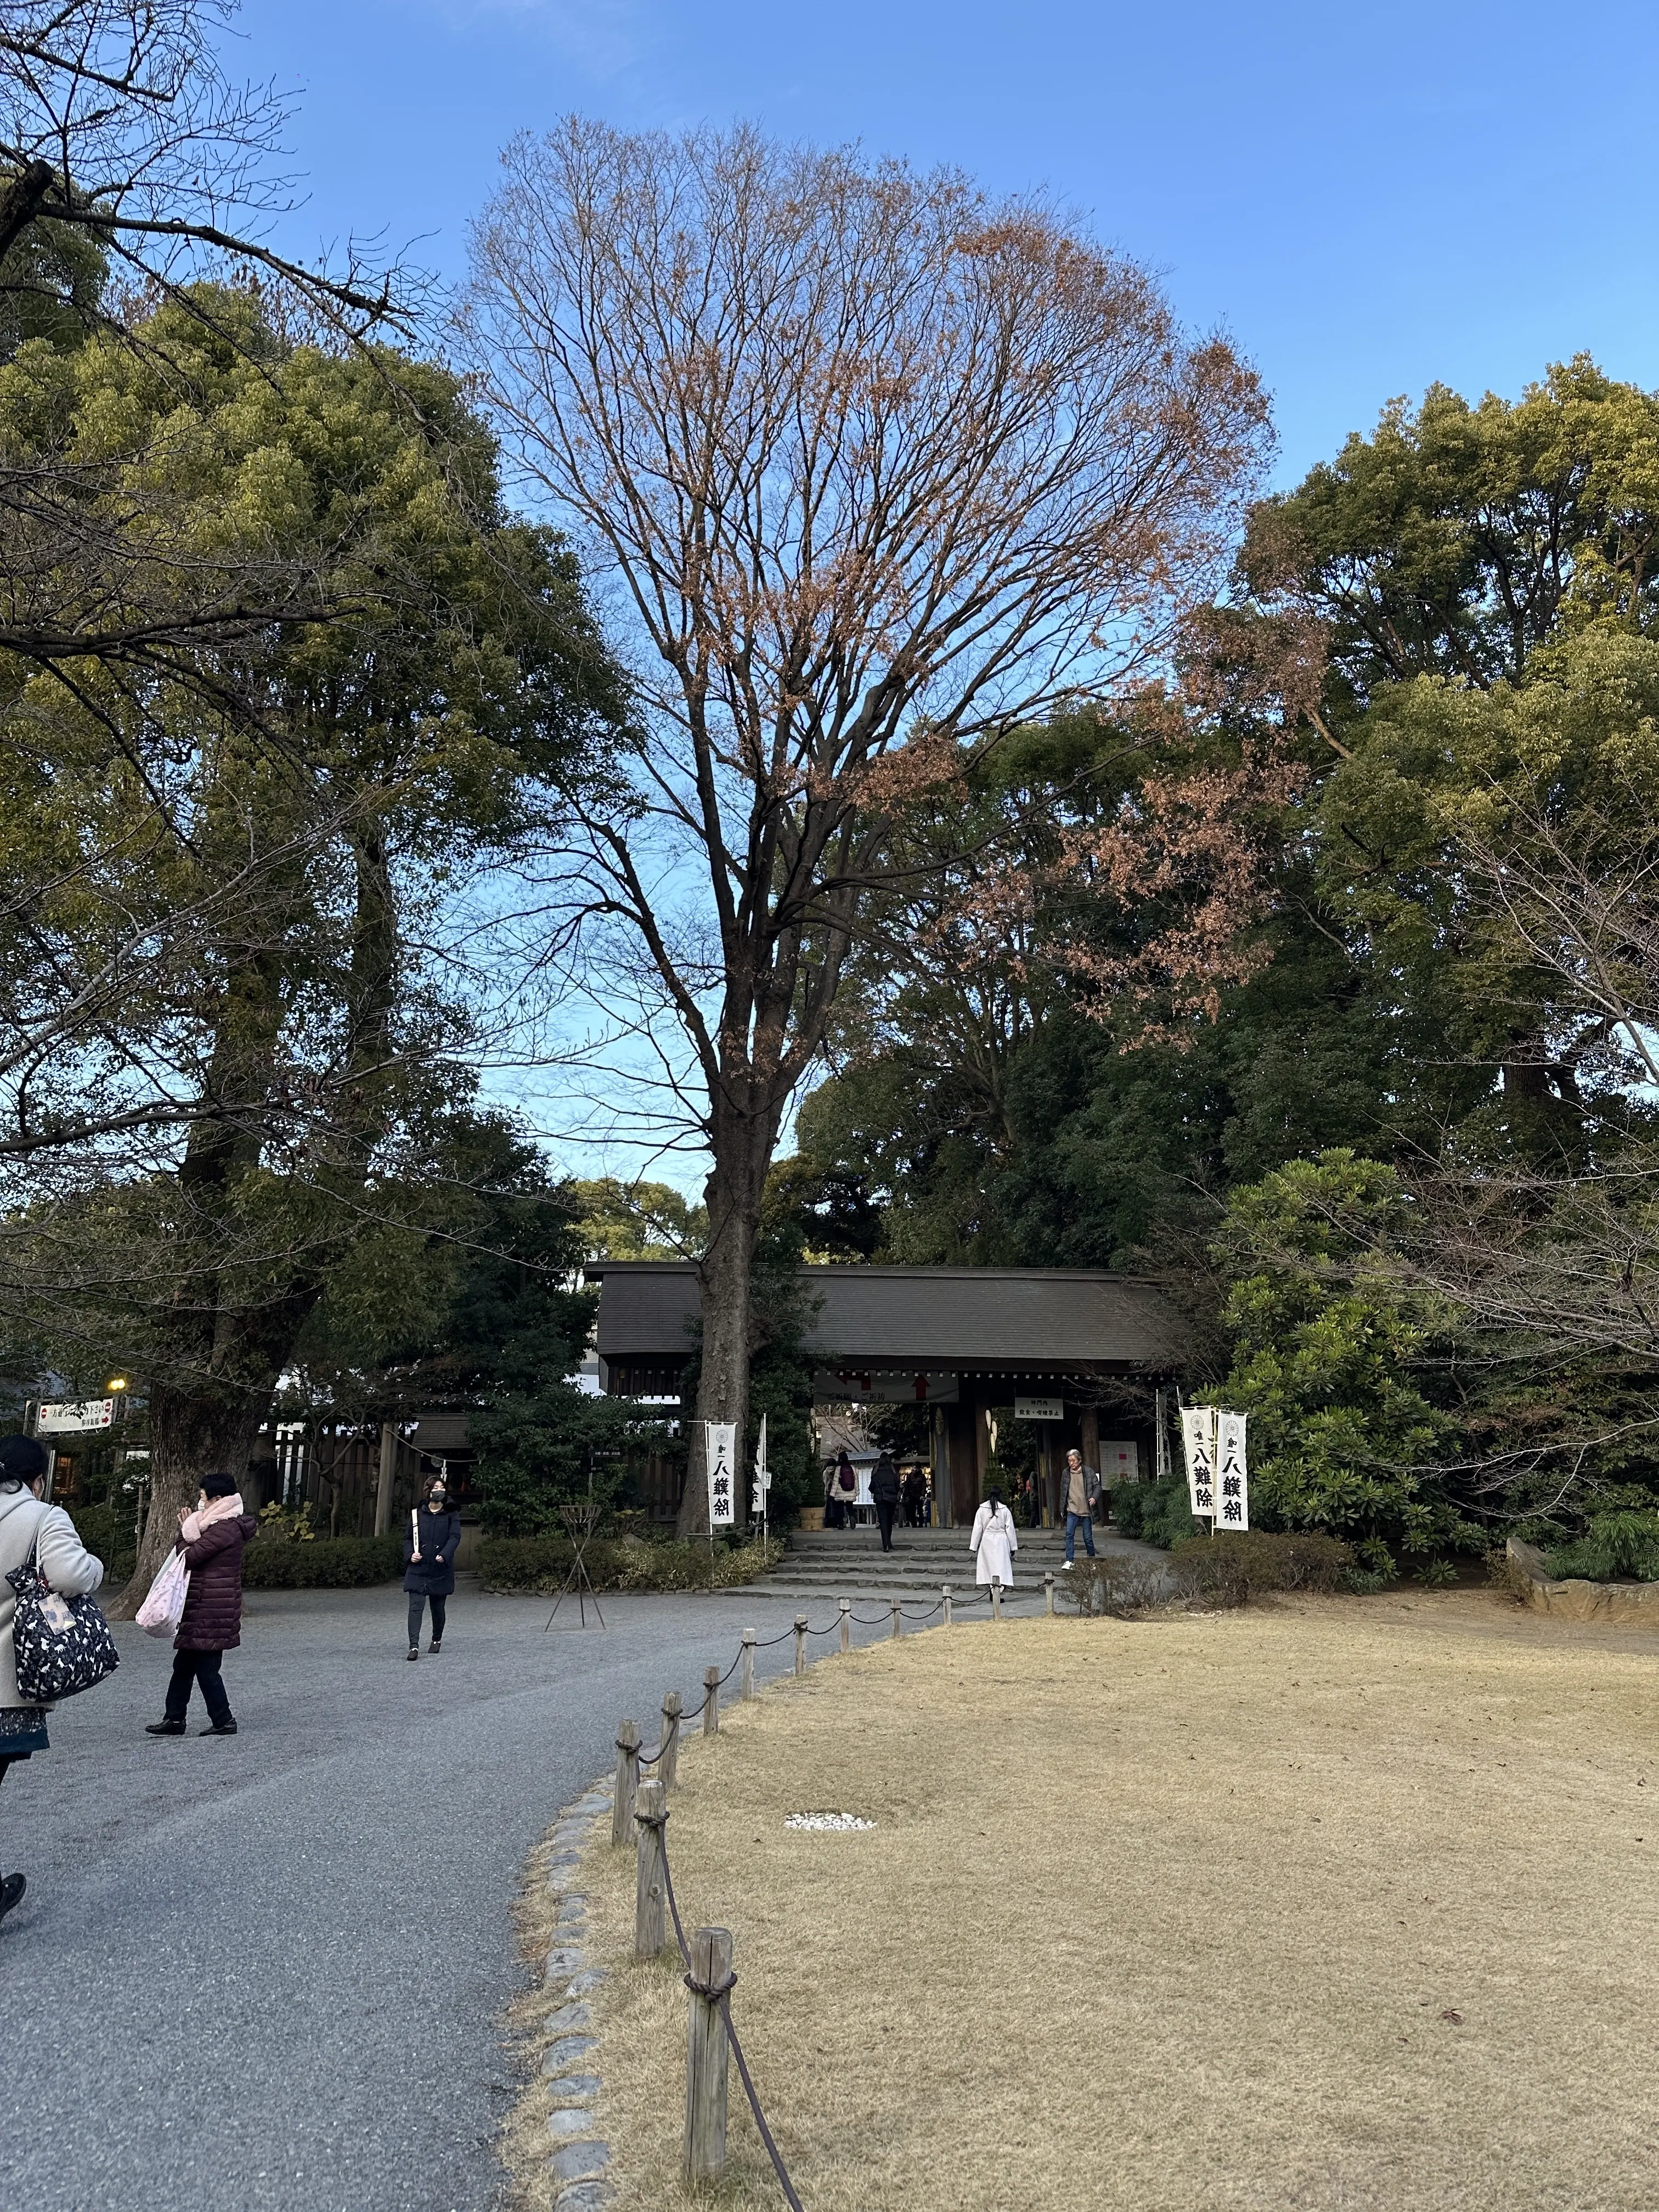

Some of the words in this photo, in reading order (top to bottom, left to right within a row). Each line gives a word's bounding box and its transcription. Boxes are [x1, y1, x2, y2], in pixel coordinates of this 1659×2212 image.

[1192, 1430, 1213, 1508] 唯一八難除
